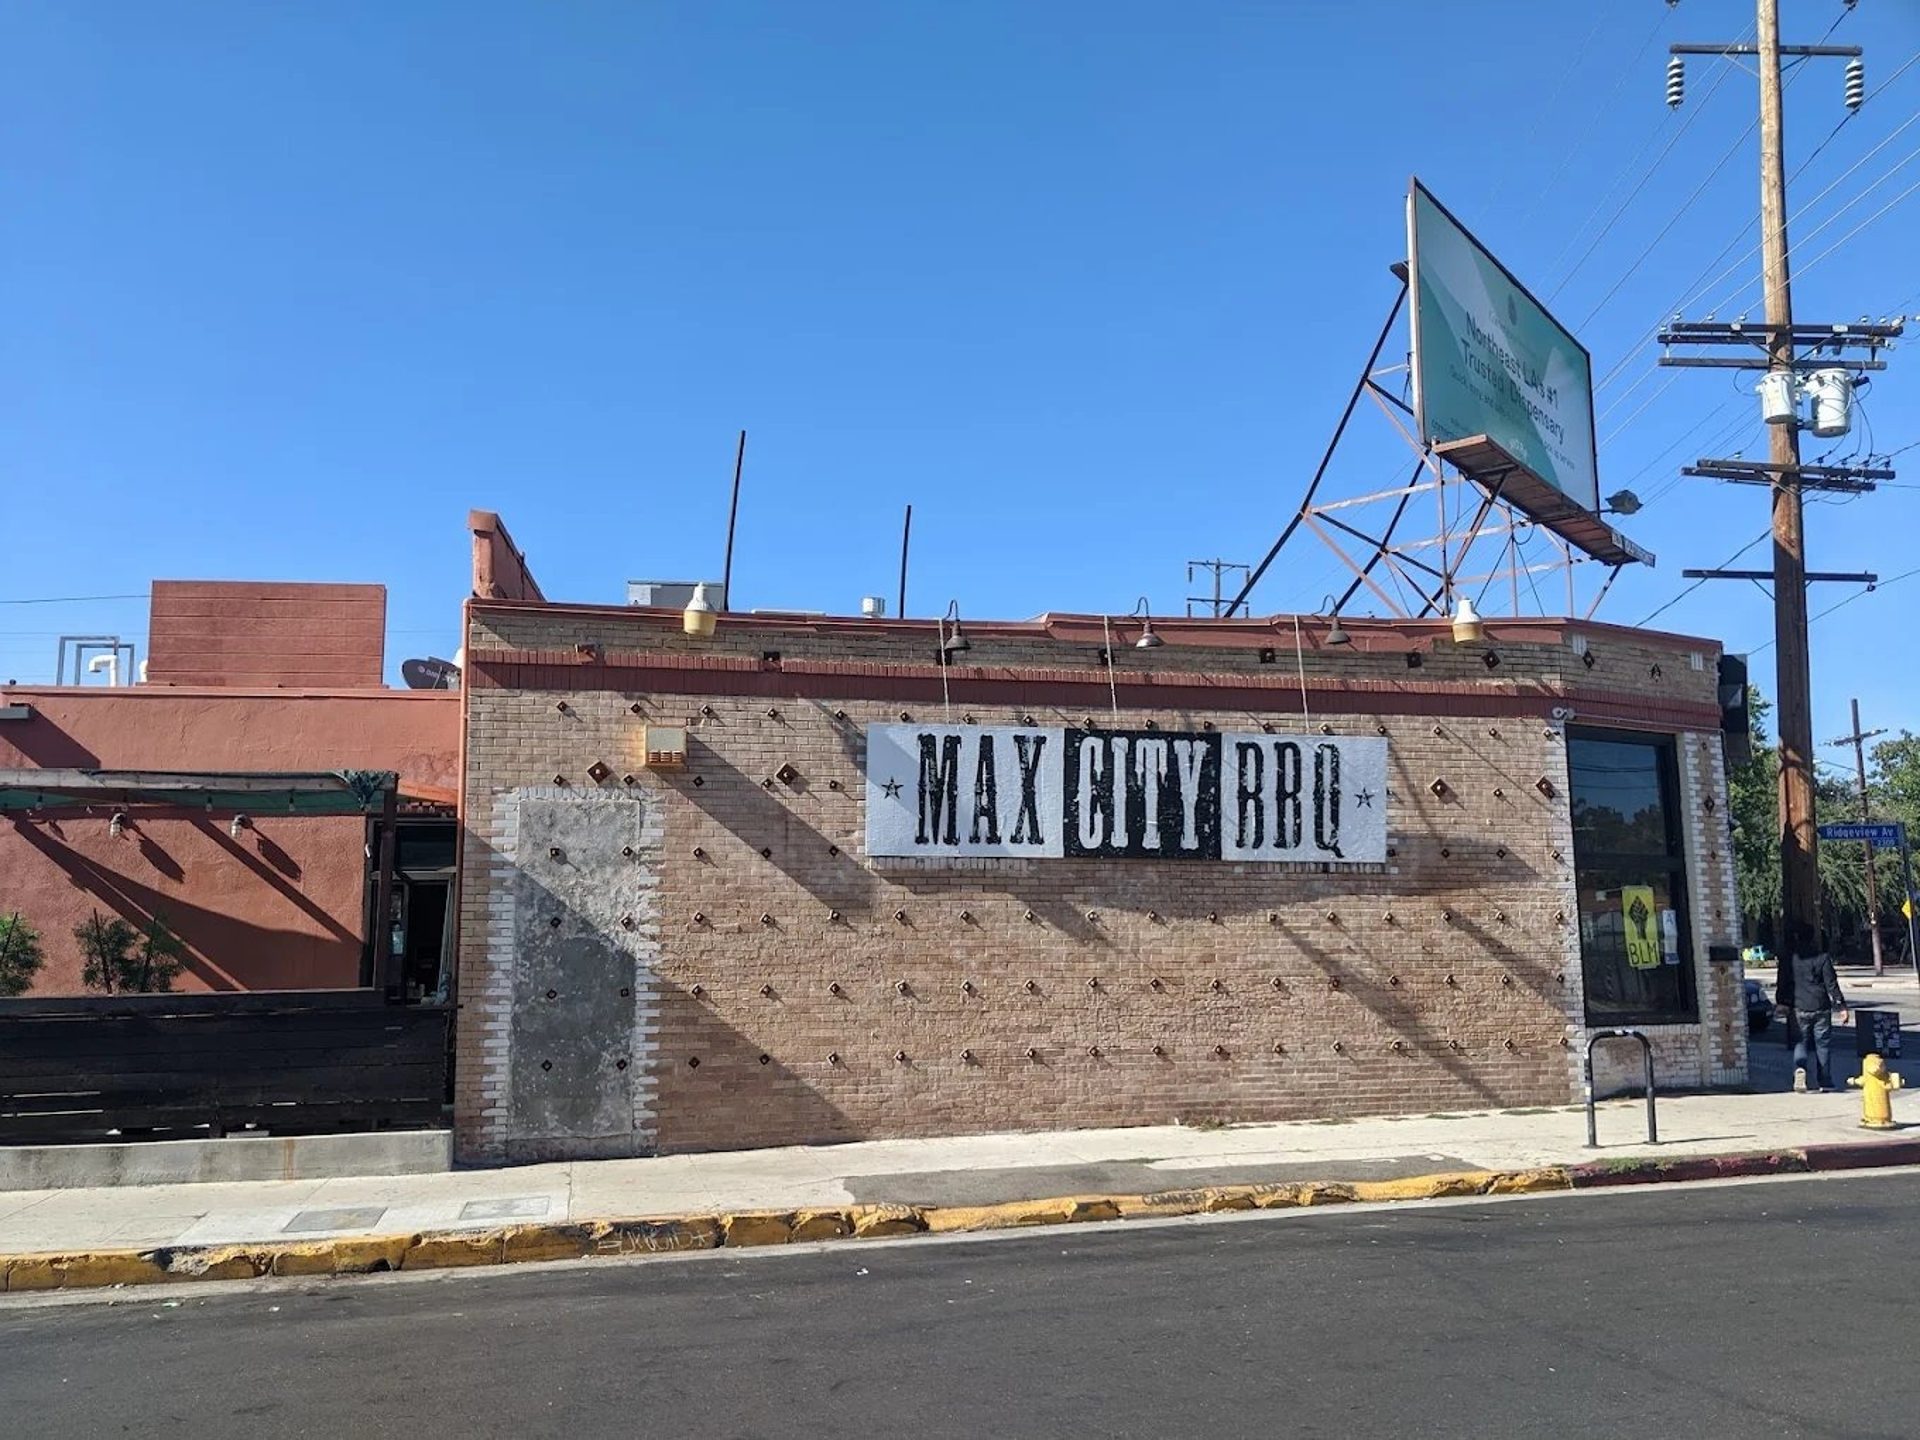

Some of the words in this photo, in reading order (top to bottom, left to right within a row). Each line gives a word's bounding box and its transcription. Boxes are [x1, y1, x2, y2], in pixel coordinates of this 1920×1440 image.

[1461, 337, 1504, 394] Trusted
[1510, 379, 1565, 445] Dispensary
[1466, 311, 1522, 381] Northeast
[1547, 386, 1559, 411] #1
[915, 733, 1047, 845] MAX
[1079, 736, 1210, 850] CITY
[1236, 741, 1344, 858] BBQ
[1826, 826, 1878, 838] Ridgeview
[1881, 826, 1894, 837] Av
[1628, 941, 1659, 965] BLM
